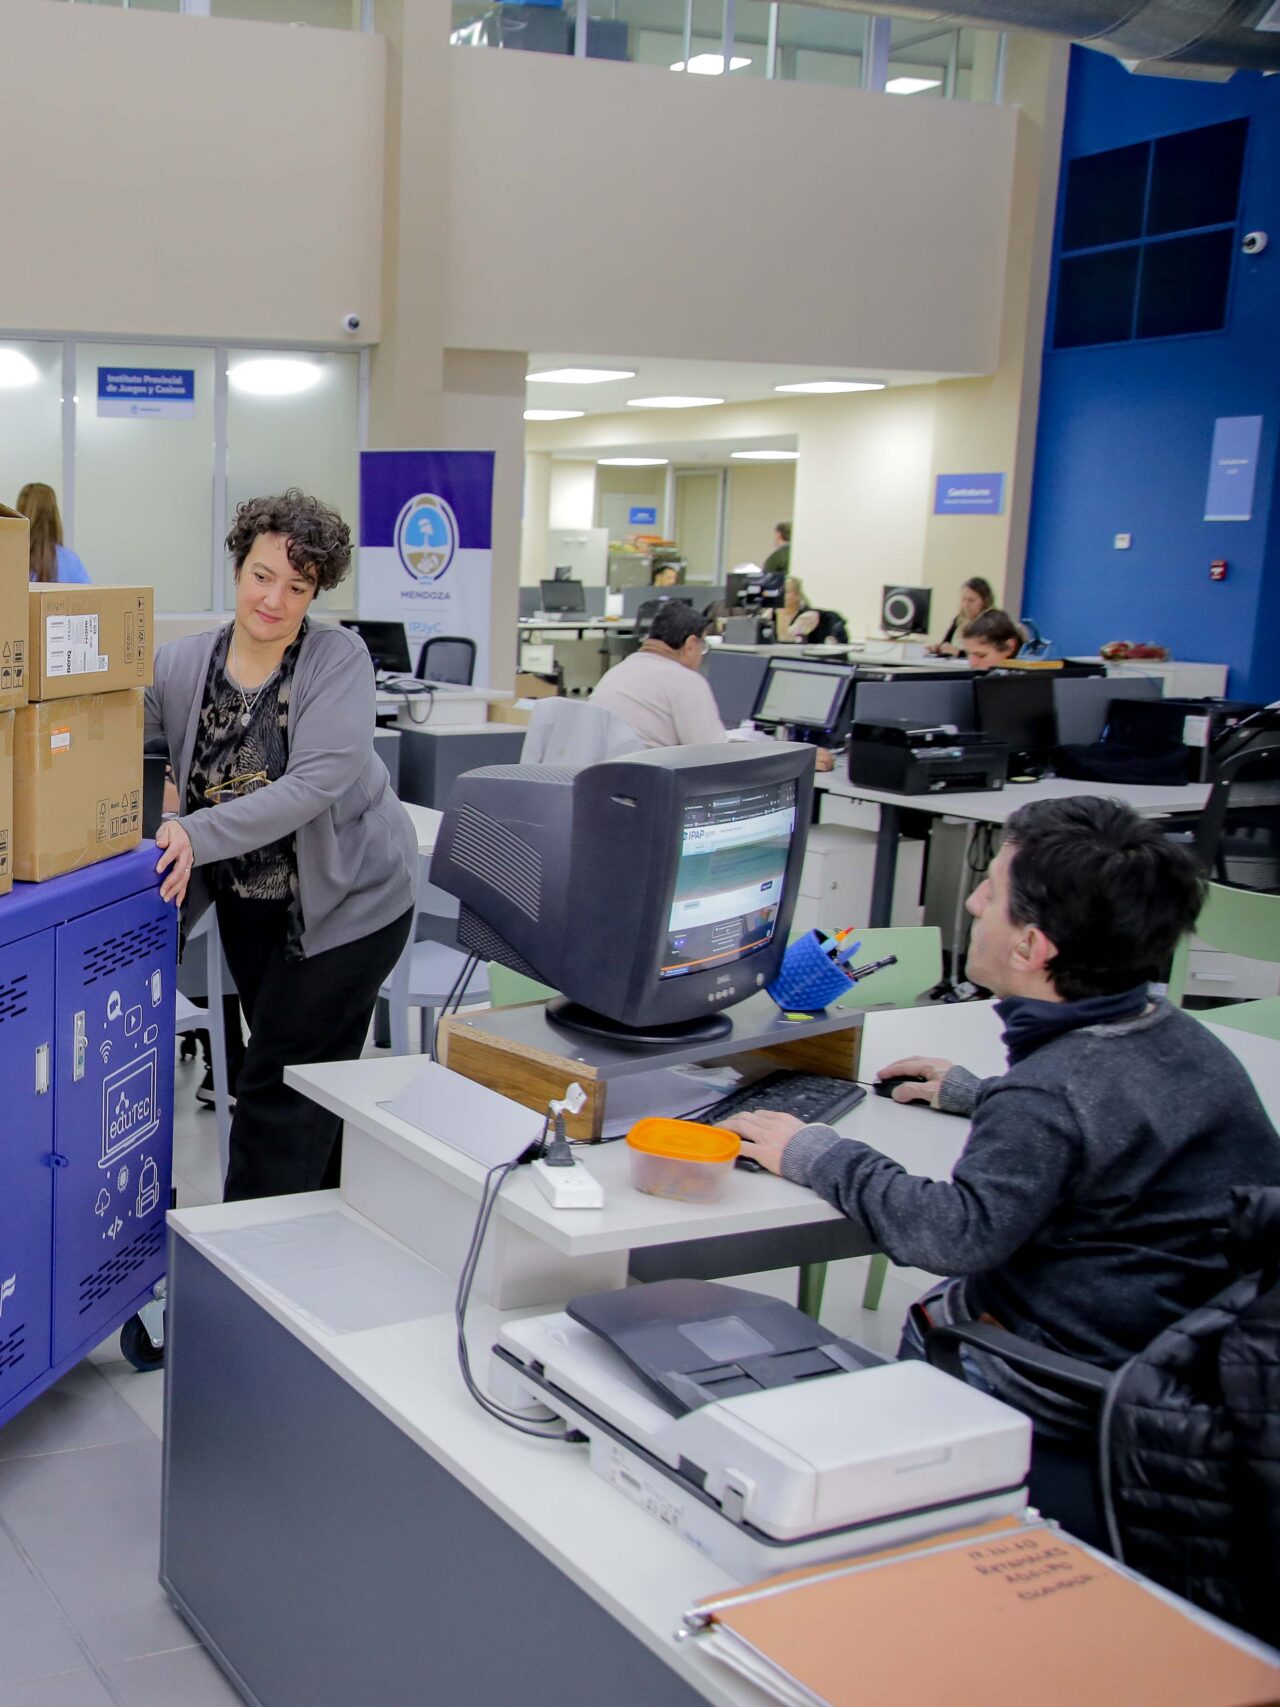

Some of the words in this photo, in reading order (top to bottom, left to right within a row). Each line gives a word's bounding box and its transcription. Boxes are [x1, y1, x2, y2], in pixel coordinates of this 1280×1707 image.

[106, 374, 142, 383] Instituto
[143, 374, 183, 385] Provincial
[119, 384, 147, 395] Juegos
[155, 385, 187, 395] Casinos
[400, 591, 451, 600] MENDOZA
